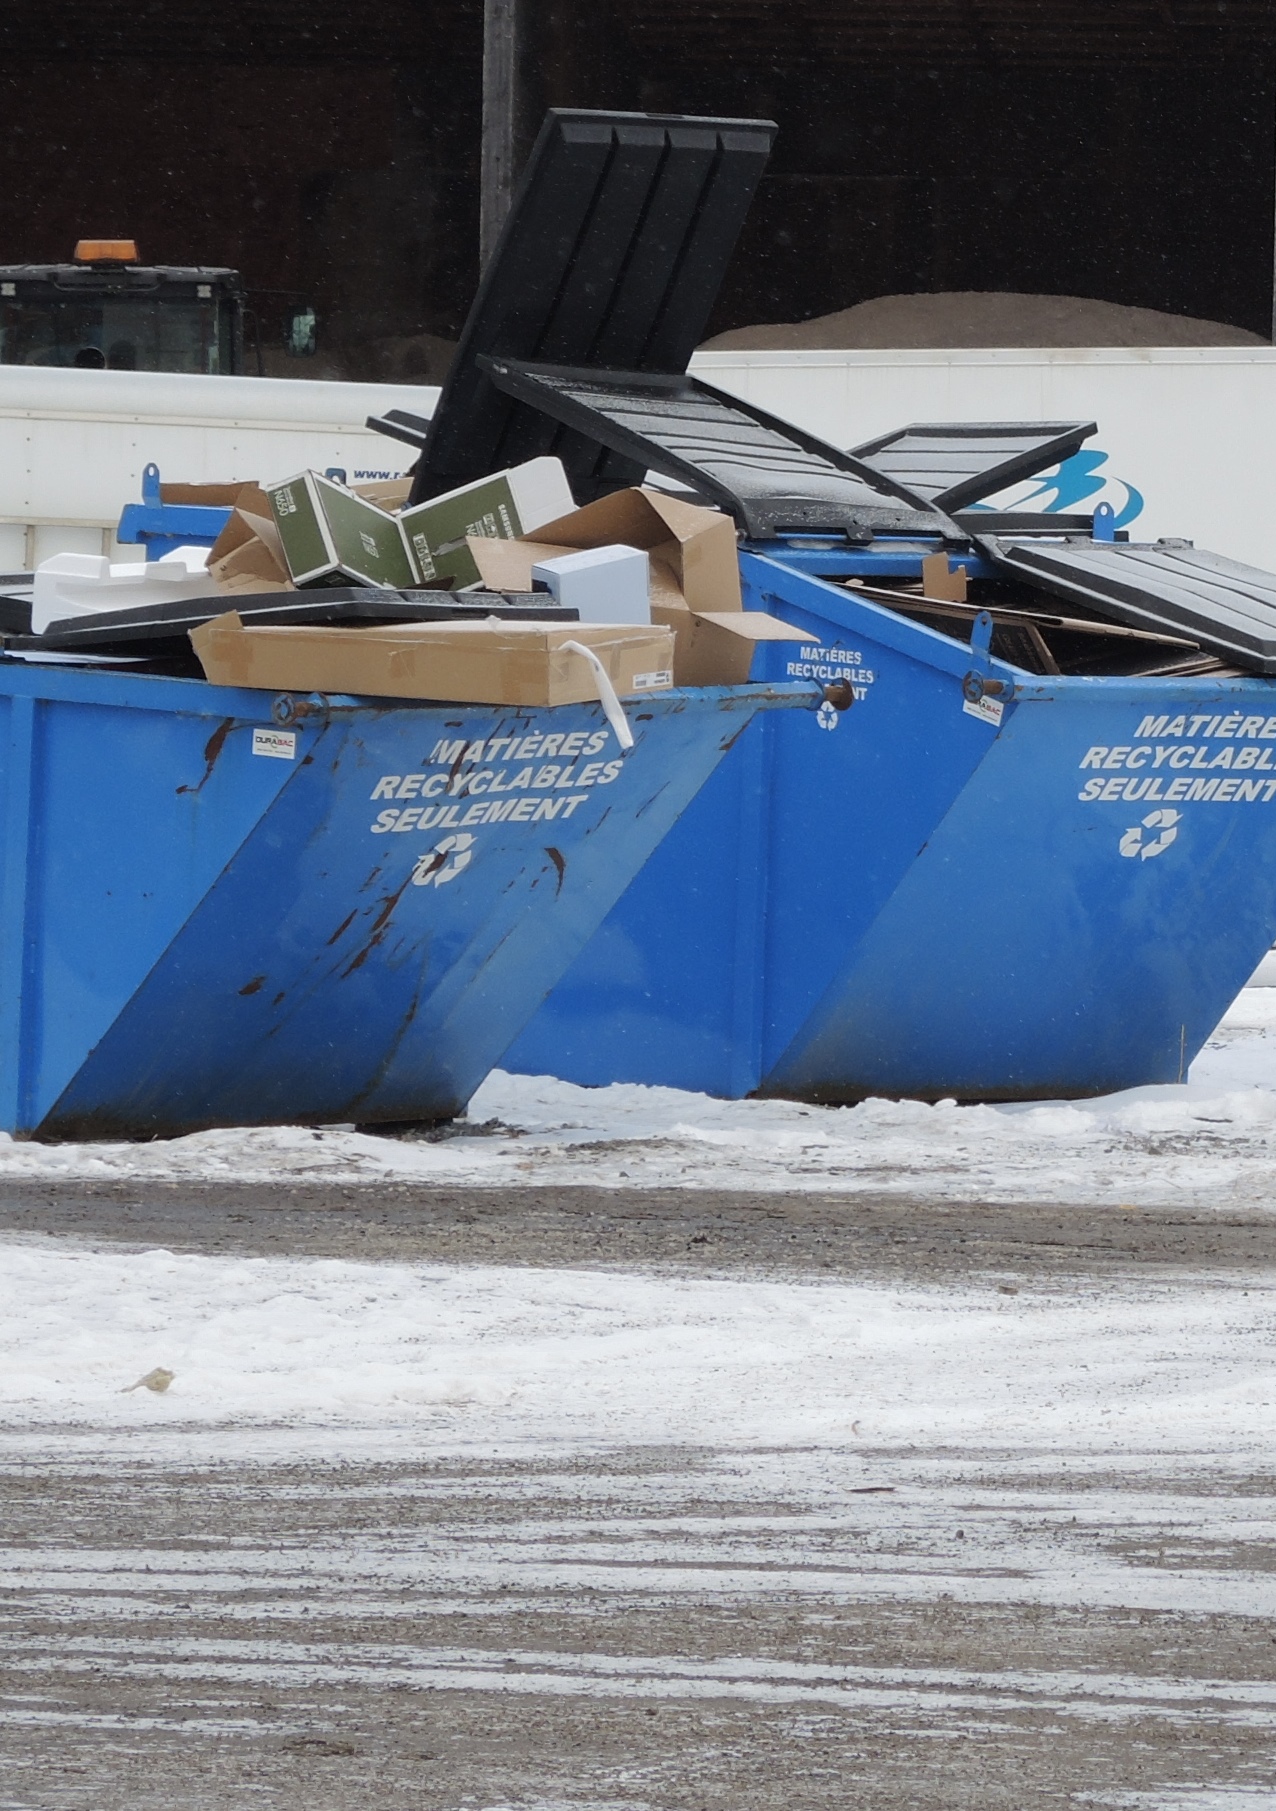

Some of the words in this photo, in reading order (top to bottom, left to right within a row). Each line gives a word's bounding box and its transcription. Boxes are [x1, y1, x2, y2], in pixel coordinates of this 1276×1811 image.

[786, 661, 874, 684] RECYCLABLES
[800, 646, 862, 666] MATIÈRES
[428, 730, 609, 765] MATIÈRES
[369, 760, 624, 800] RECYCLABLES
[370, 794, 589, 834] SEULEMENT
